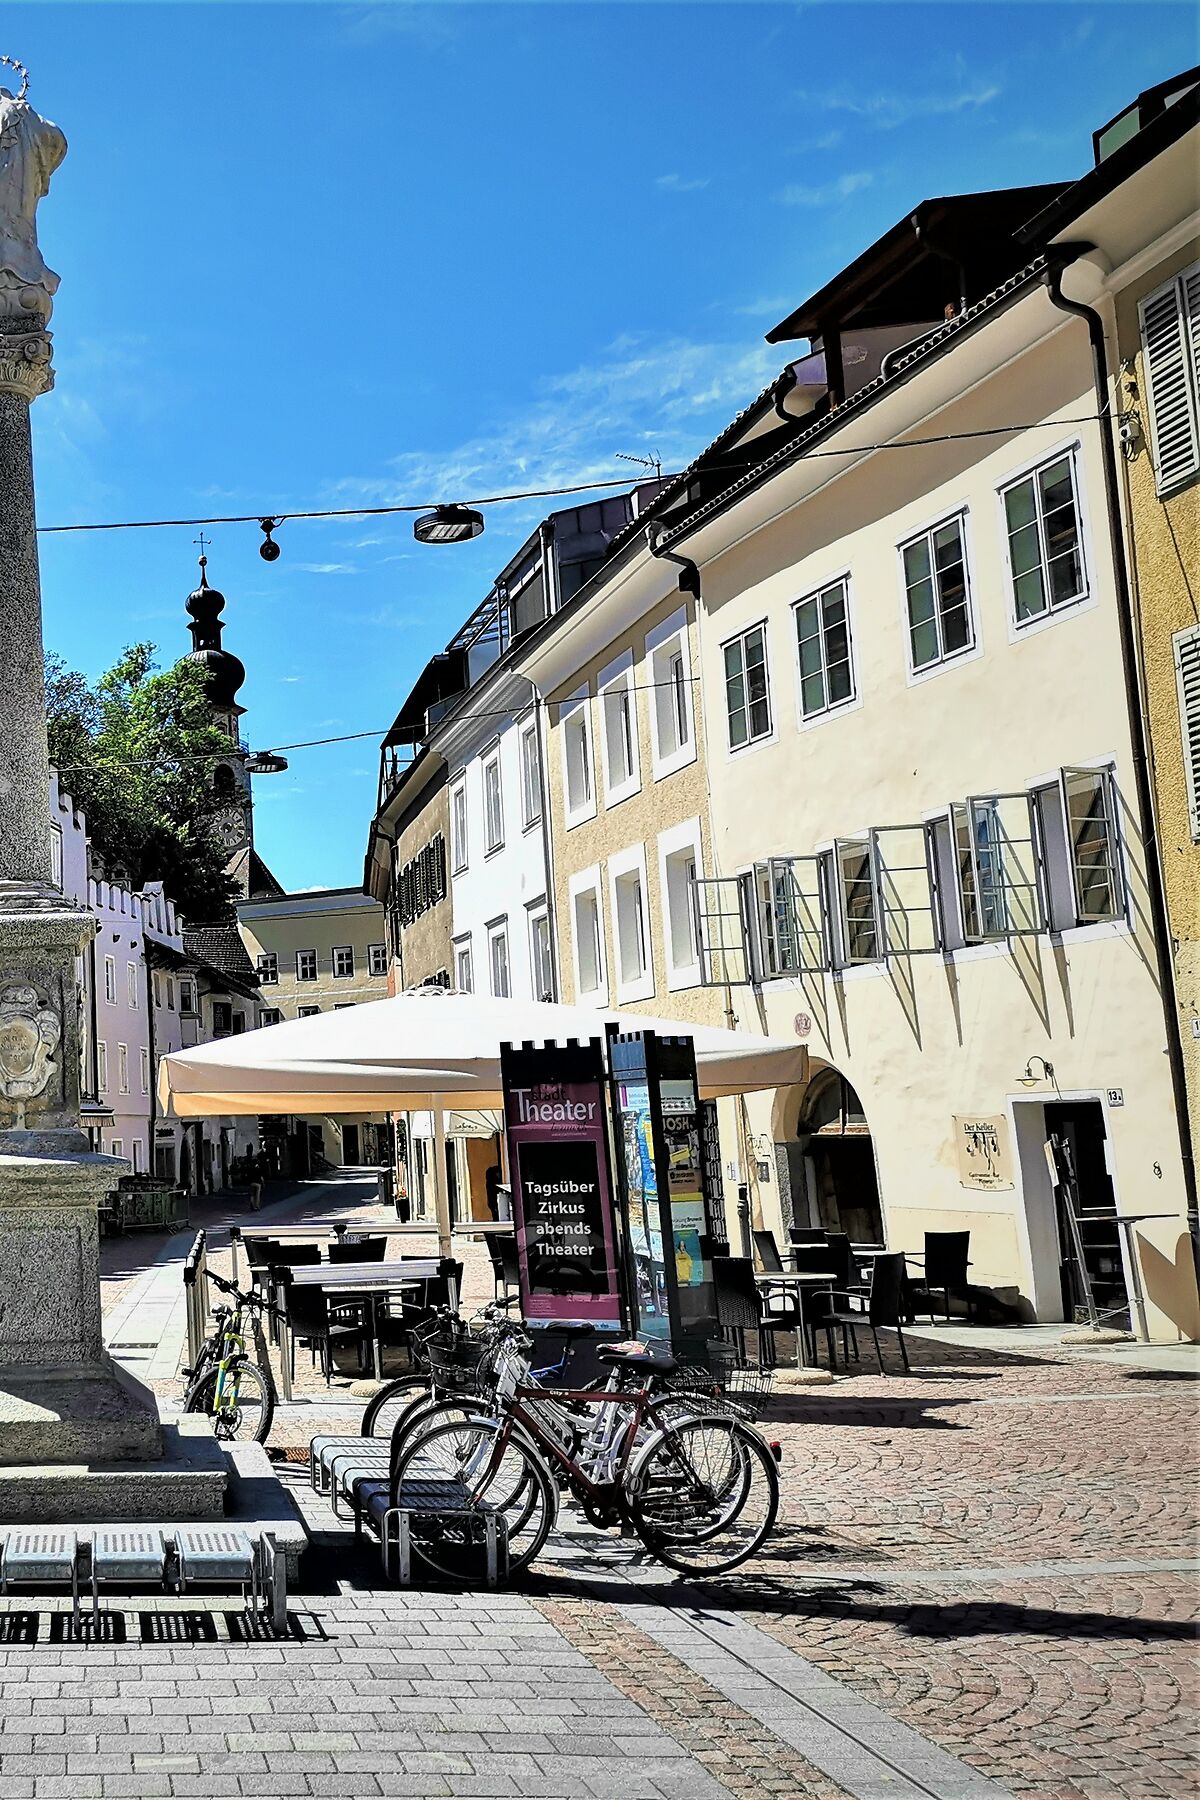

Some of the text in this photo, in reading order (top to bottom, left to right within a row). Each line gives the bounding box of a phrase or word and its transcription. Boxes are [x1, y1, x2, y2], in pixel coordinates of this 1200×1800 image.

[532, 1086, 568, 1101] stadt
[509, 1088, 596, 1122] Theater
[964, 1122, 993, 1131] Der Keller
[525, 1181, 595, 1197] Tagsüber
[538, 1201, 586, 1214] Zirkus
[536, 1222, 592, 1235] abends
[536, 1243, 595, 1256] Theater
